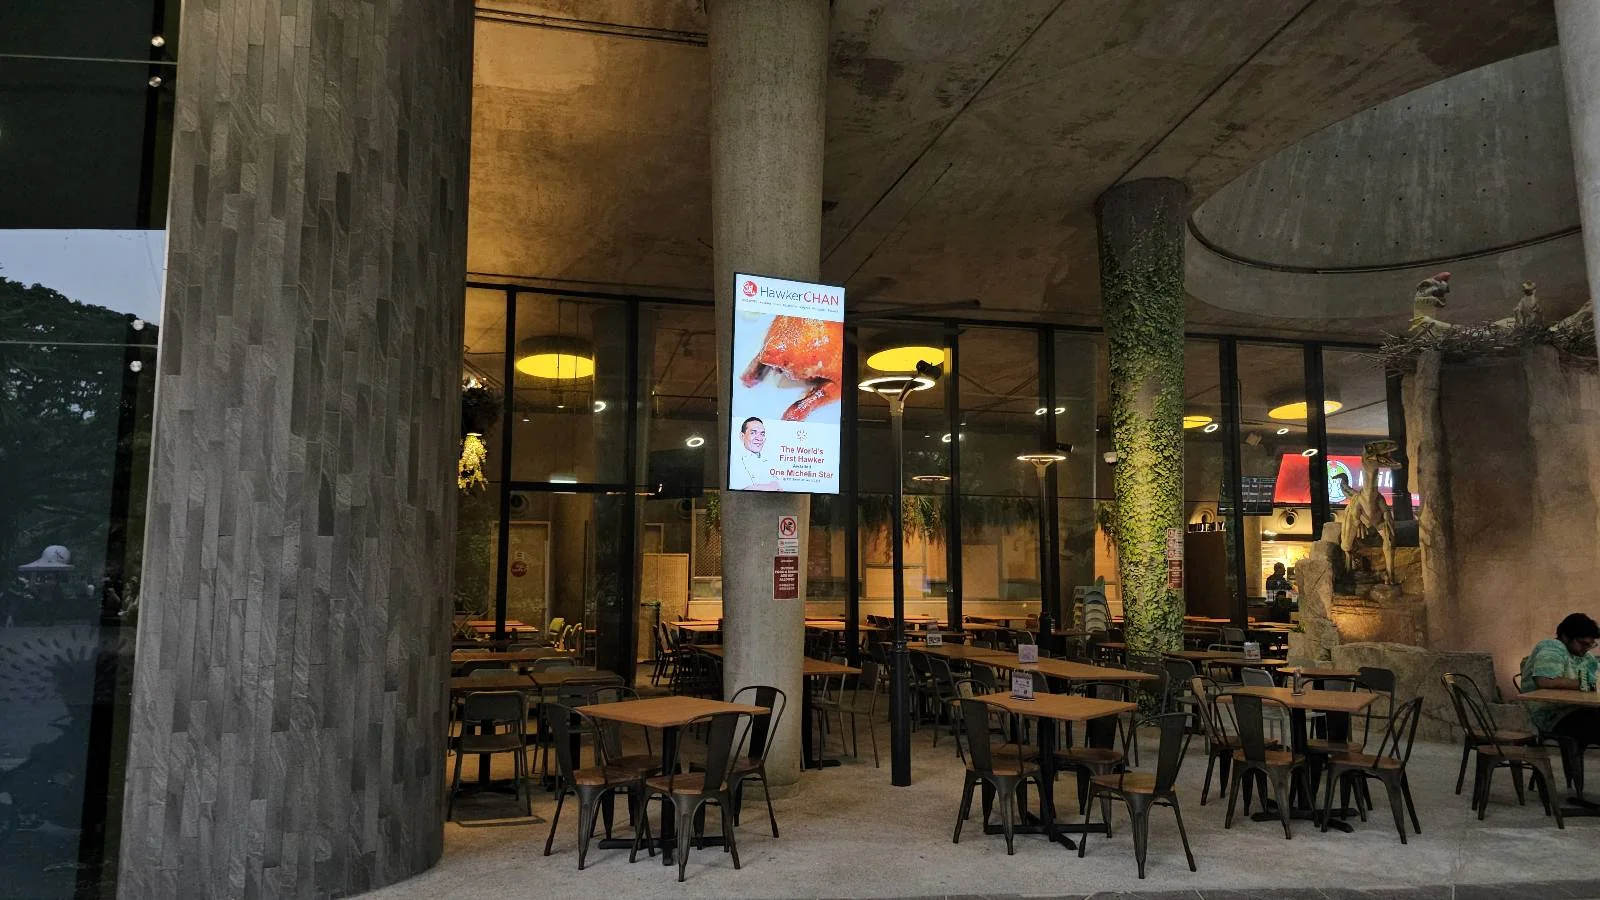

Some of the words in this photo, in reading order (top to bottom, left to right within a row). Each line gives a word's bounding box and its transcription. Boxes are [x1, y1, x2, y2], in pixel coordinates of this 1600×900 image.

[796, 446, 824, 455] World's
[797, 456, 825, 464] Hawker
[769, 468, 785, 476] One
[786, 469, 817, 477] Michelin
[818, 471, 834, 479] Star
